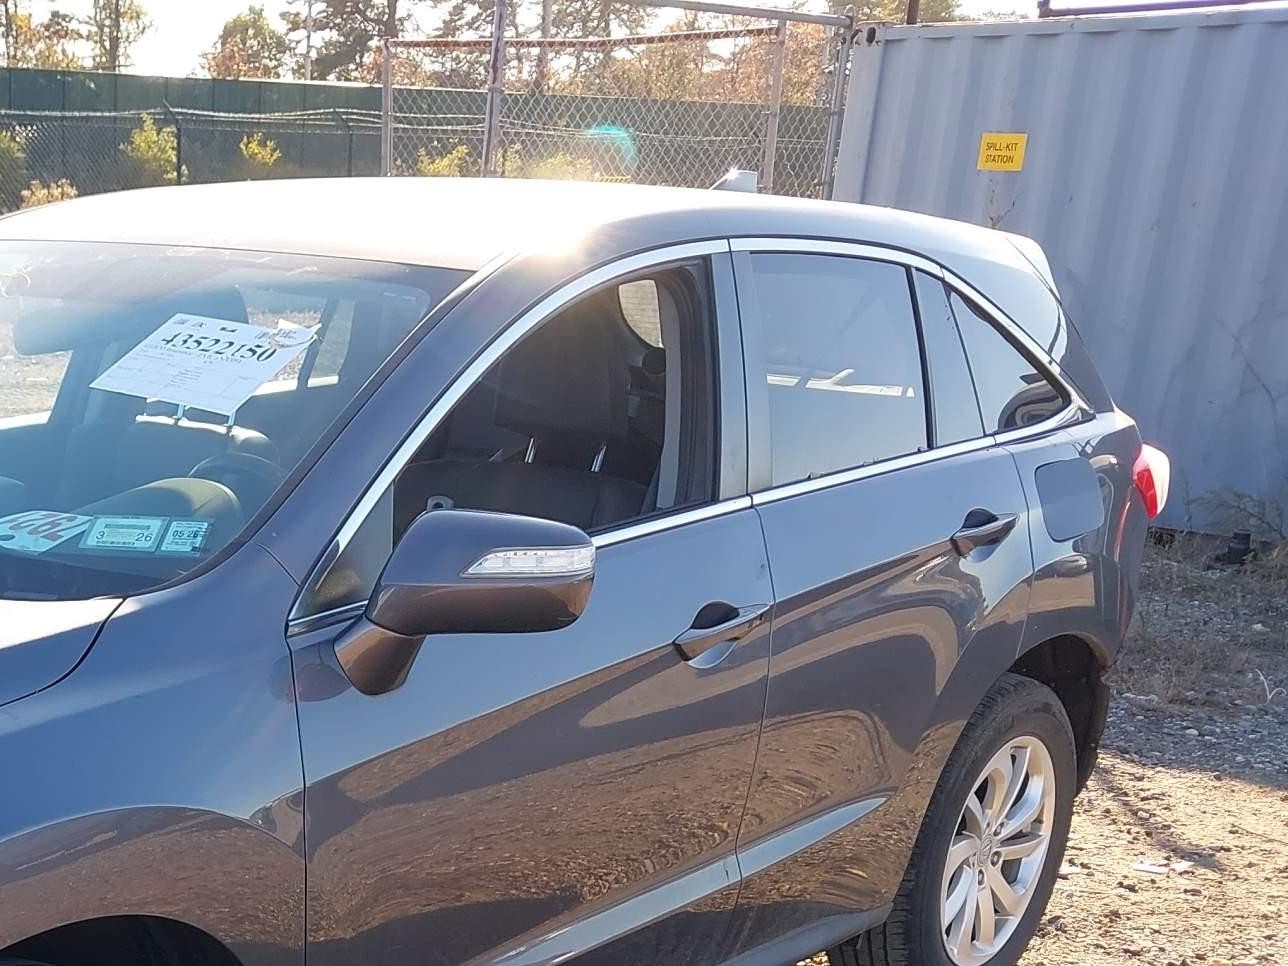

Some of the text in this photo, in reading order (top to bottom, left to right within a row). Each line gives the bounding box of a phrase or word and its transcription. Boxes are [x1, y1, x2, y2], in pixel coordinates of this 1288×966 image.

[986, 142, 1019, 151] SPILL-KIT
[985, 154, 1014, 164] STATION
[161, 332, 278, 362] 43522150
[95, 530, 153, 542] 3 26
